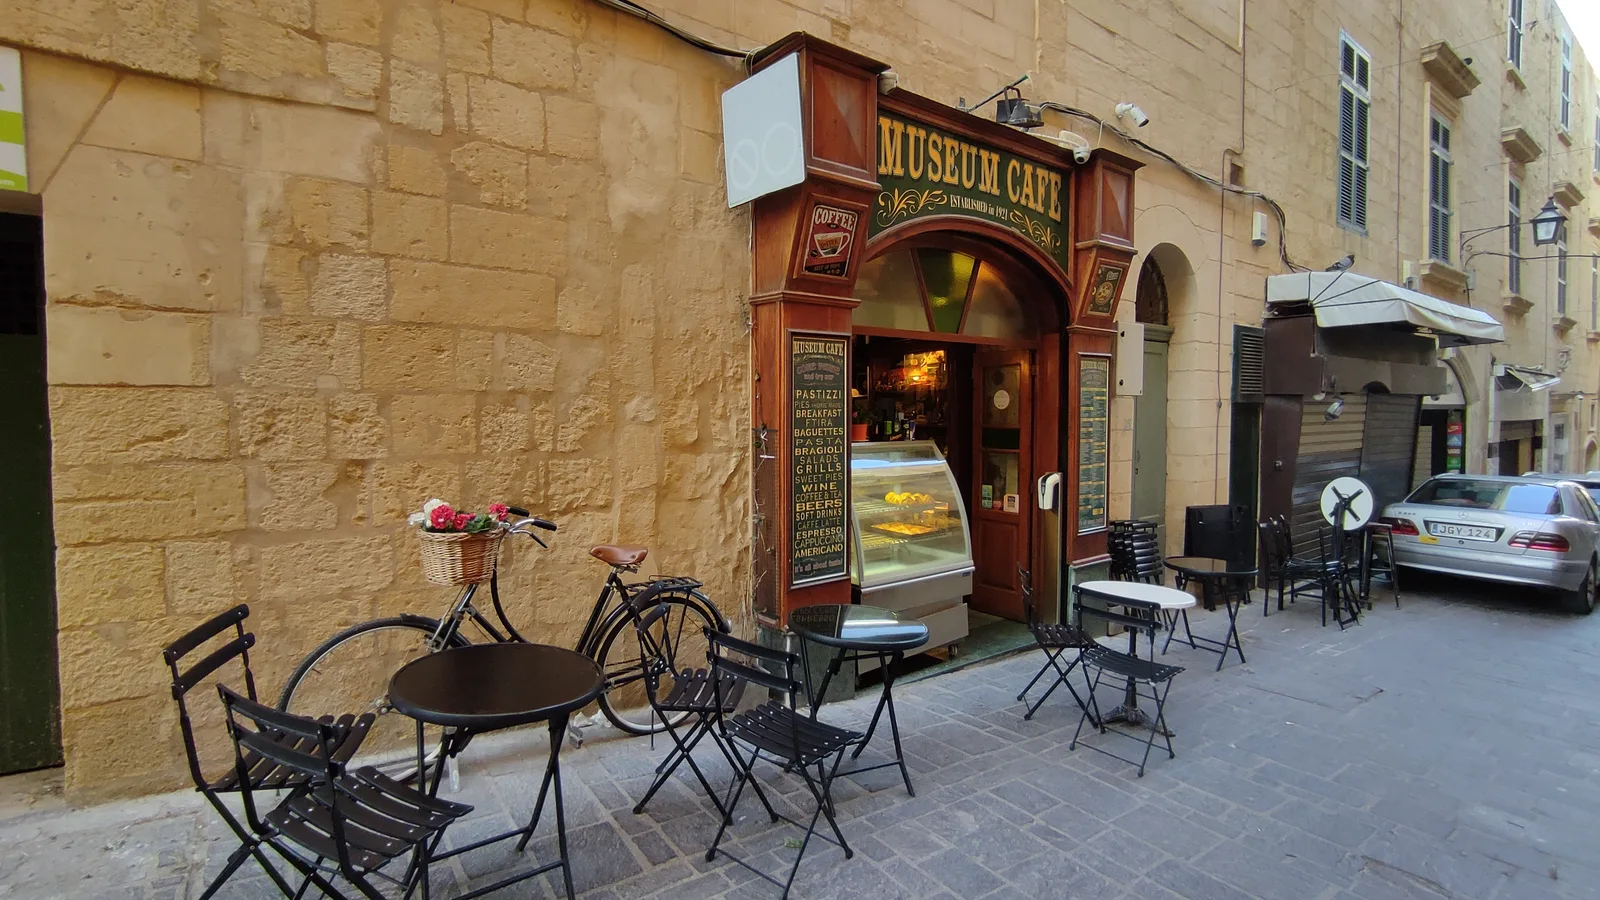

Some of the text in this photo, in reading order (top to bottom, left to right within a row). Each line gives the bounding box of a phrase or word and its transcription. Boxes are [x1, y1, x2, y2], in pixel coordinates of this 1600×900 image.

[878, 116, 1062, 223] MUSEUM CAFE
[950, 194, 988, 213] ESTABLISHED
[988, 203, 995, 216] in
[814, 207, 854, 231] COFFEE
[793, 341, 843, 356] MUSEUM CAFE
[796, 389, 842, 399] PASTIZZI
[794, 400, 810, 409] PIES
[795, 409, 843, 418] BREAKFAST
[805, 418, 833, 427] FTIRA
[794, 427, 844, 437] BAGUETTES
[795, 437, 843, 446] PASTA
[795, 446, 843, 456] BRAGIOLI
[800, 455, 839, 465] SALADS
[796, 463, 842, 474] GRILLS
[795, 472, 843, 484] SWEET PIES
[801, 482, 837, 493] WINE
[795, 490, 843, 503] COFFEE & TEA
[796, 498, 843, 512] BEERS
[796, 508, 842, 521] SOFT DRINKS
[820, 517, 841, 529] LATTE
[796, 526, 842, 540] ESPRESSO
[1439, 525, 1490, 539] JGY 124
[794, 534, 844, 550] CAPPUCCINO
[795, 543, 843, 559] AMERICANO
